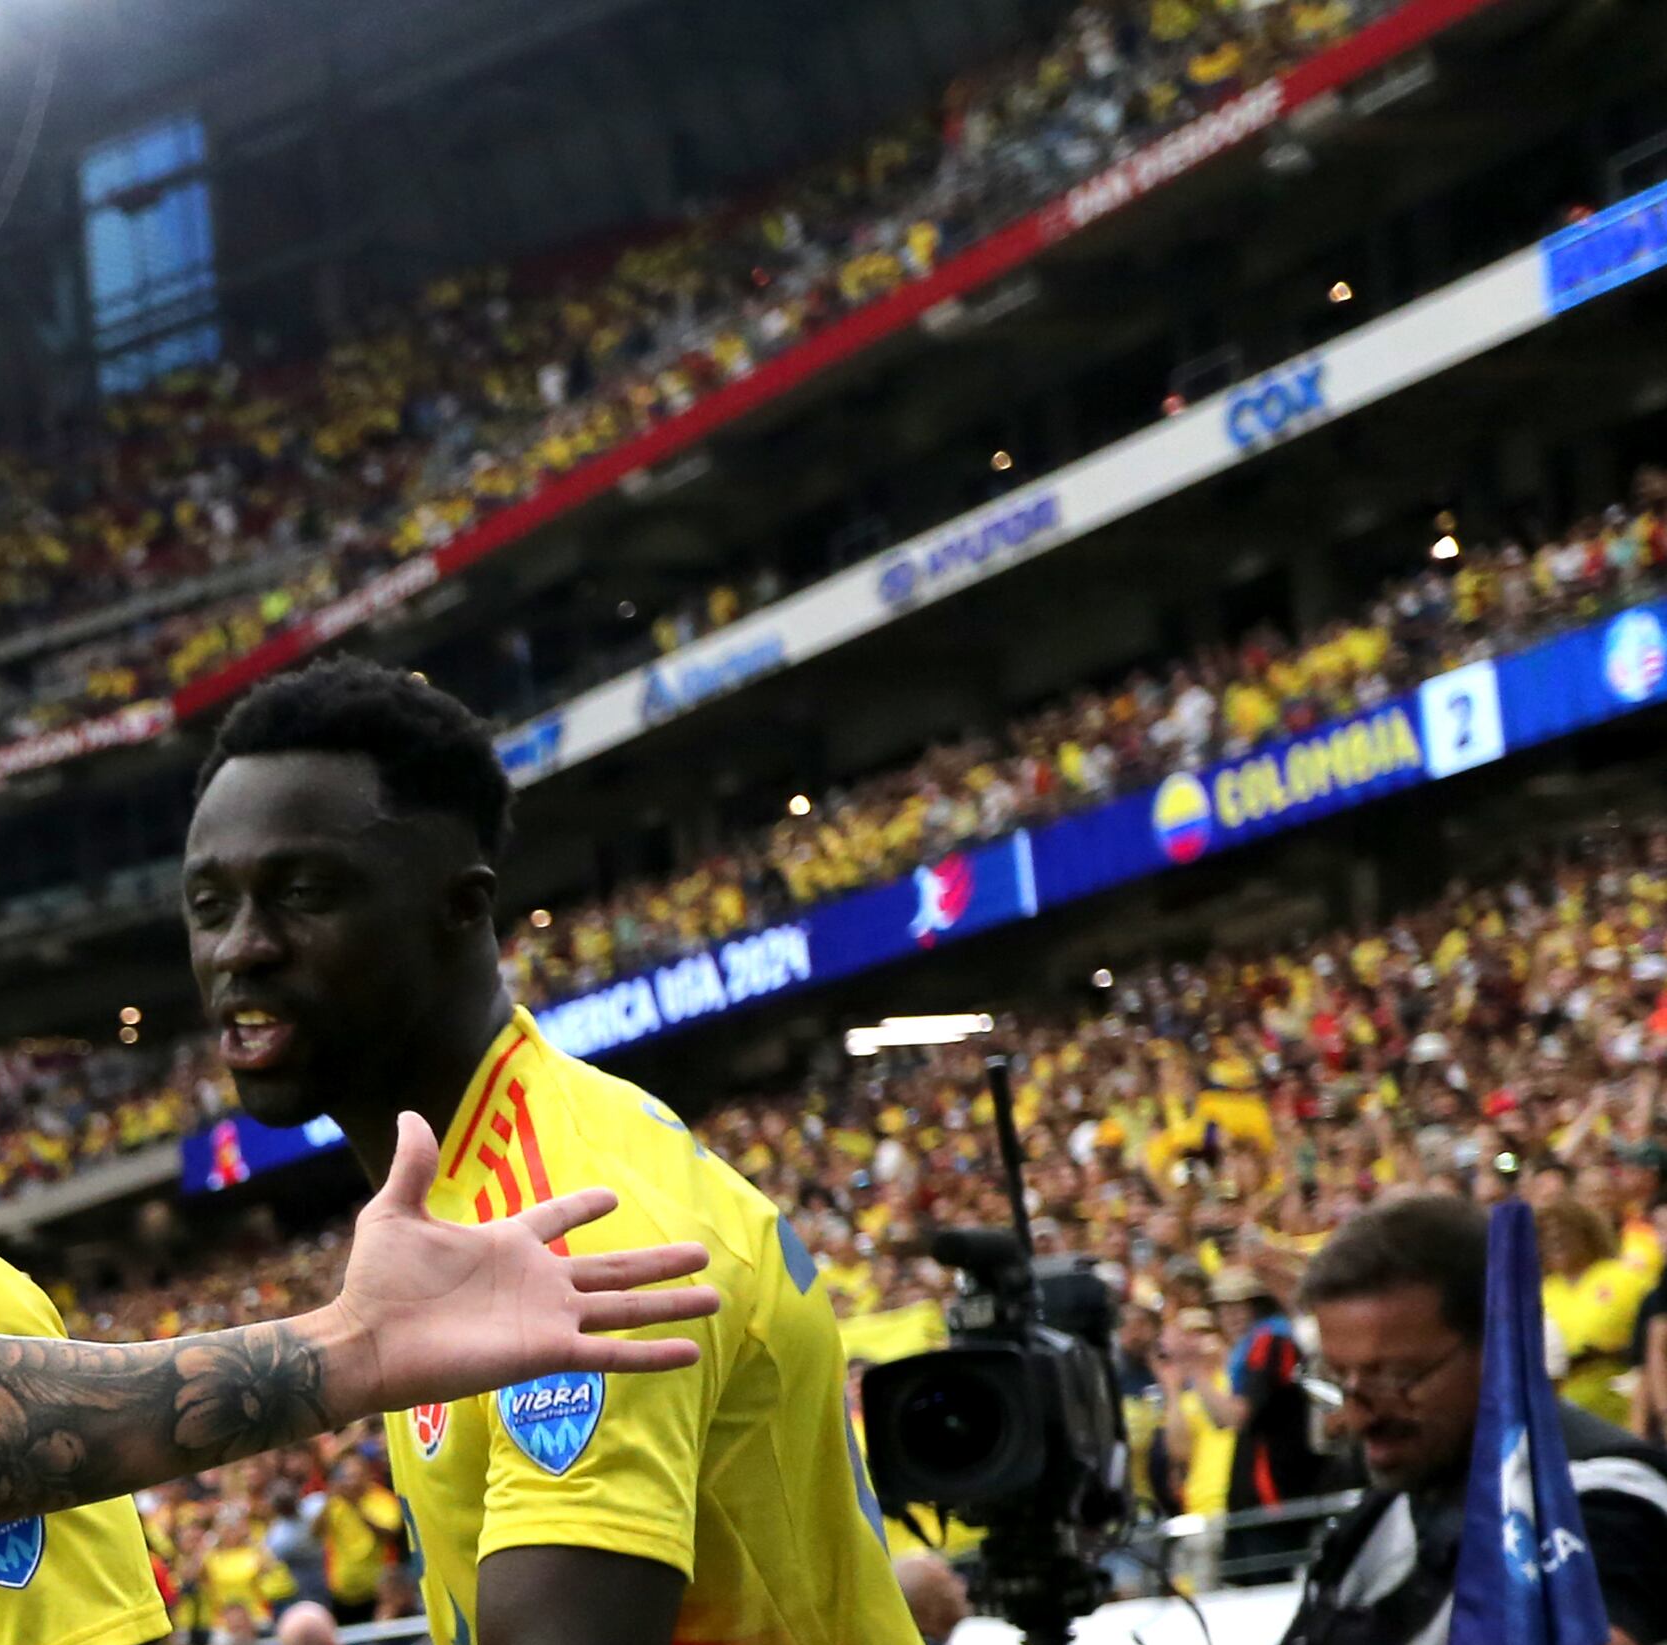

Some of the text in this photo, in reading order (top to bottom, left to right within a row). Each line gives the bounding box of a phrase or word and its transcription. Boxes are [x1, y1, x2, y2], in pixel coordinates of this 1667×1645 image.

[1224, 353, 1328, 450] COX
[1447, 688, 1475, 752] 2
[1214, 704, 1421, 830] COLOMBIA
[719, 923, 812, 1005] 2024
[512, 1382, 591, 1415] VIBRA
